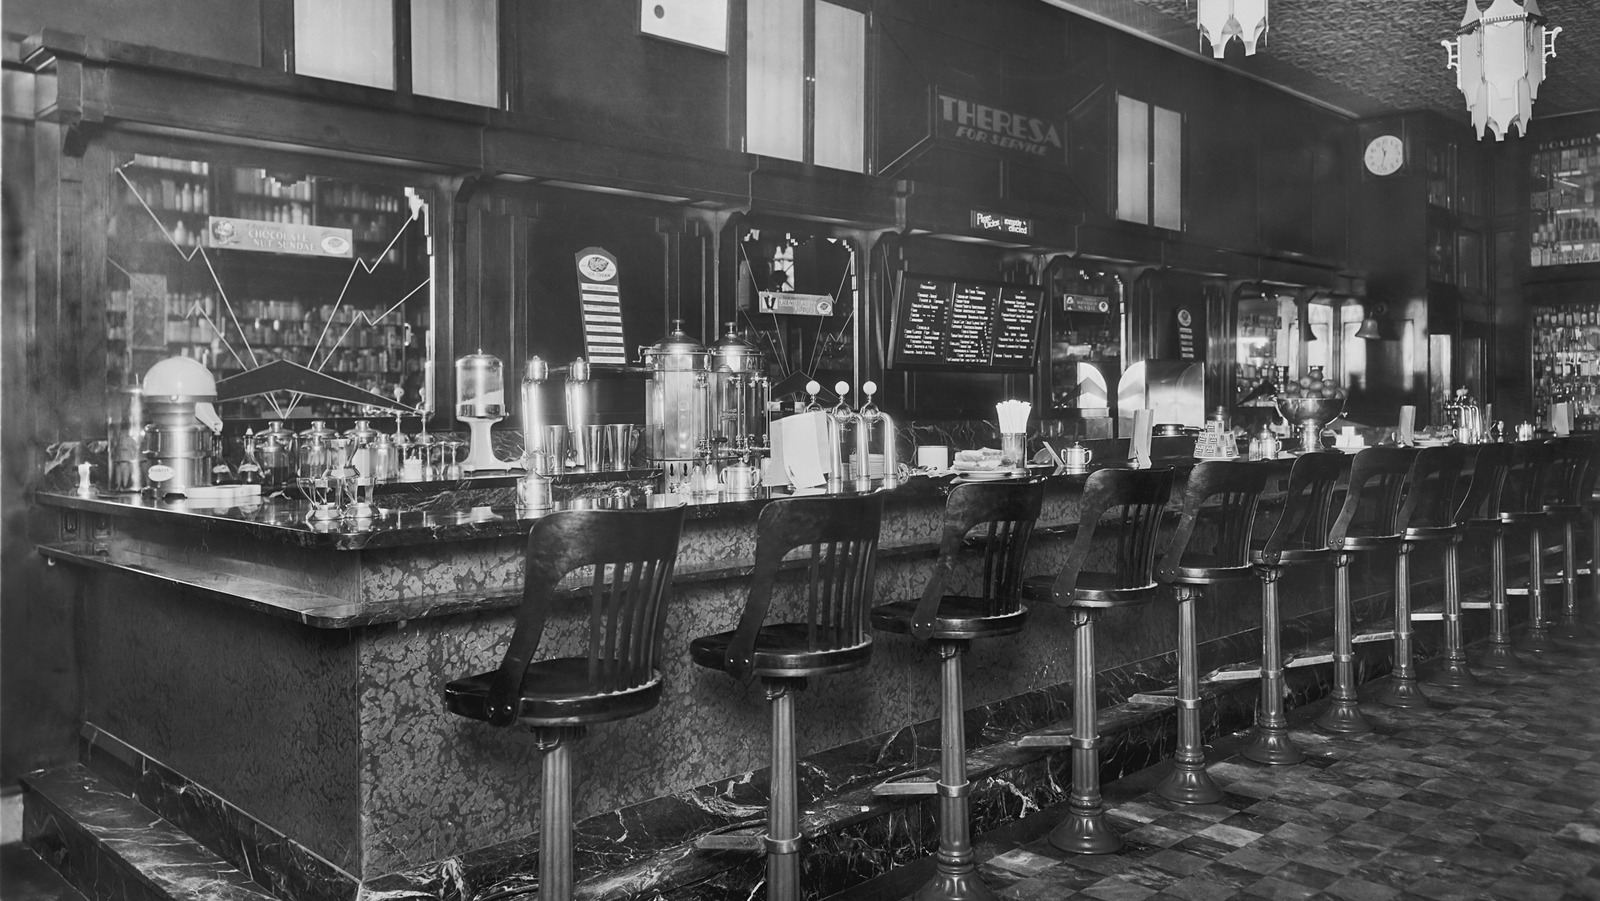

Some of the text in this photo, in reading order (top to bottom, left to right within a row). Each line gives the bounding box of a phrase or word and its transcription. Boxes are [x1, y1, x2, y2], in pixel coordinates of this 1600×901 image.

[938, 95, 1062, 148] THERESA
[956, 126, 1048, 156] FOR SERVICE
[248, 229, 308, 242] CHOCOLATE
[253, 238, 273, 248] NUT
